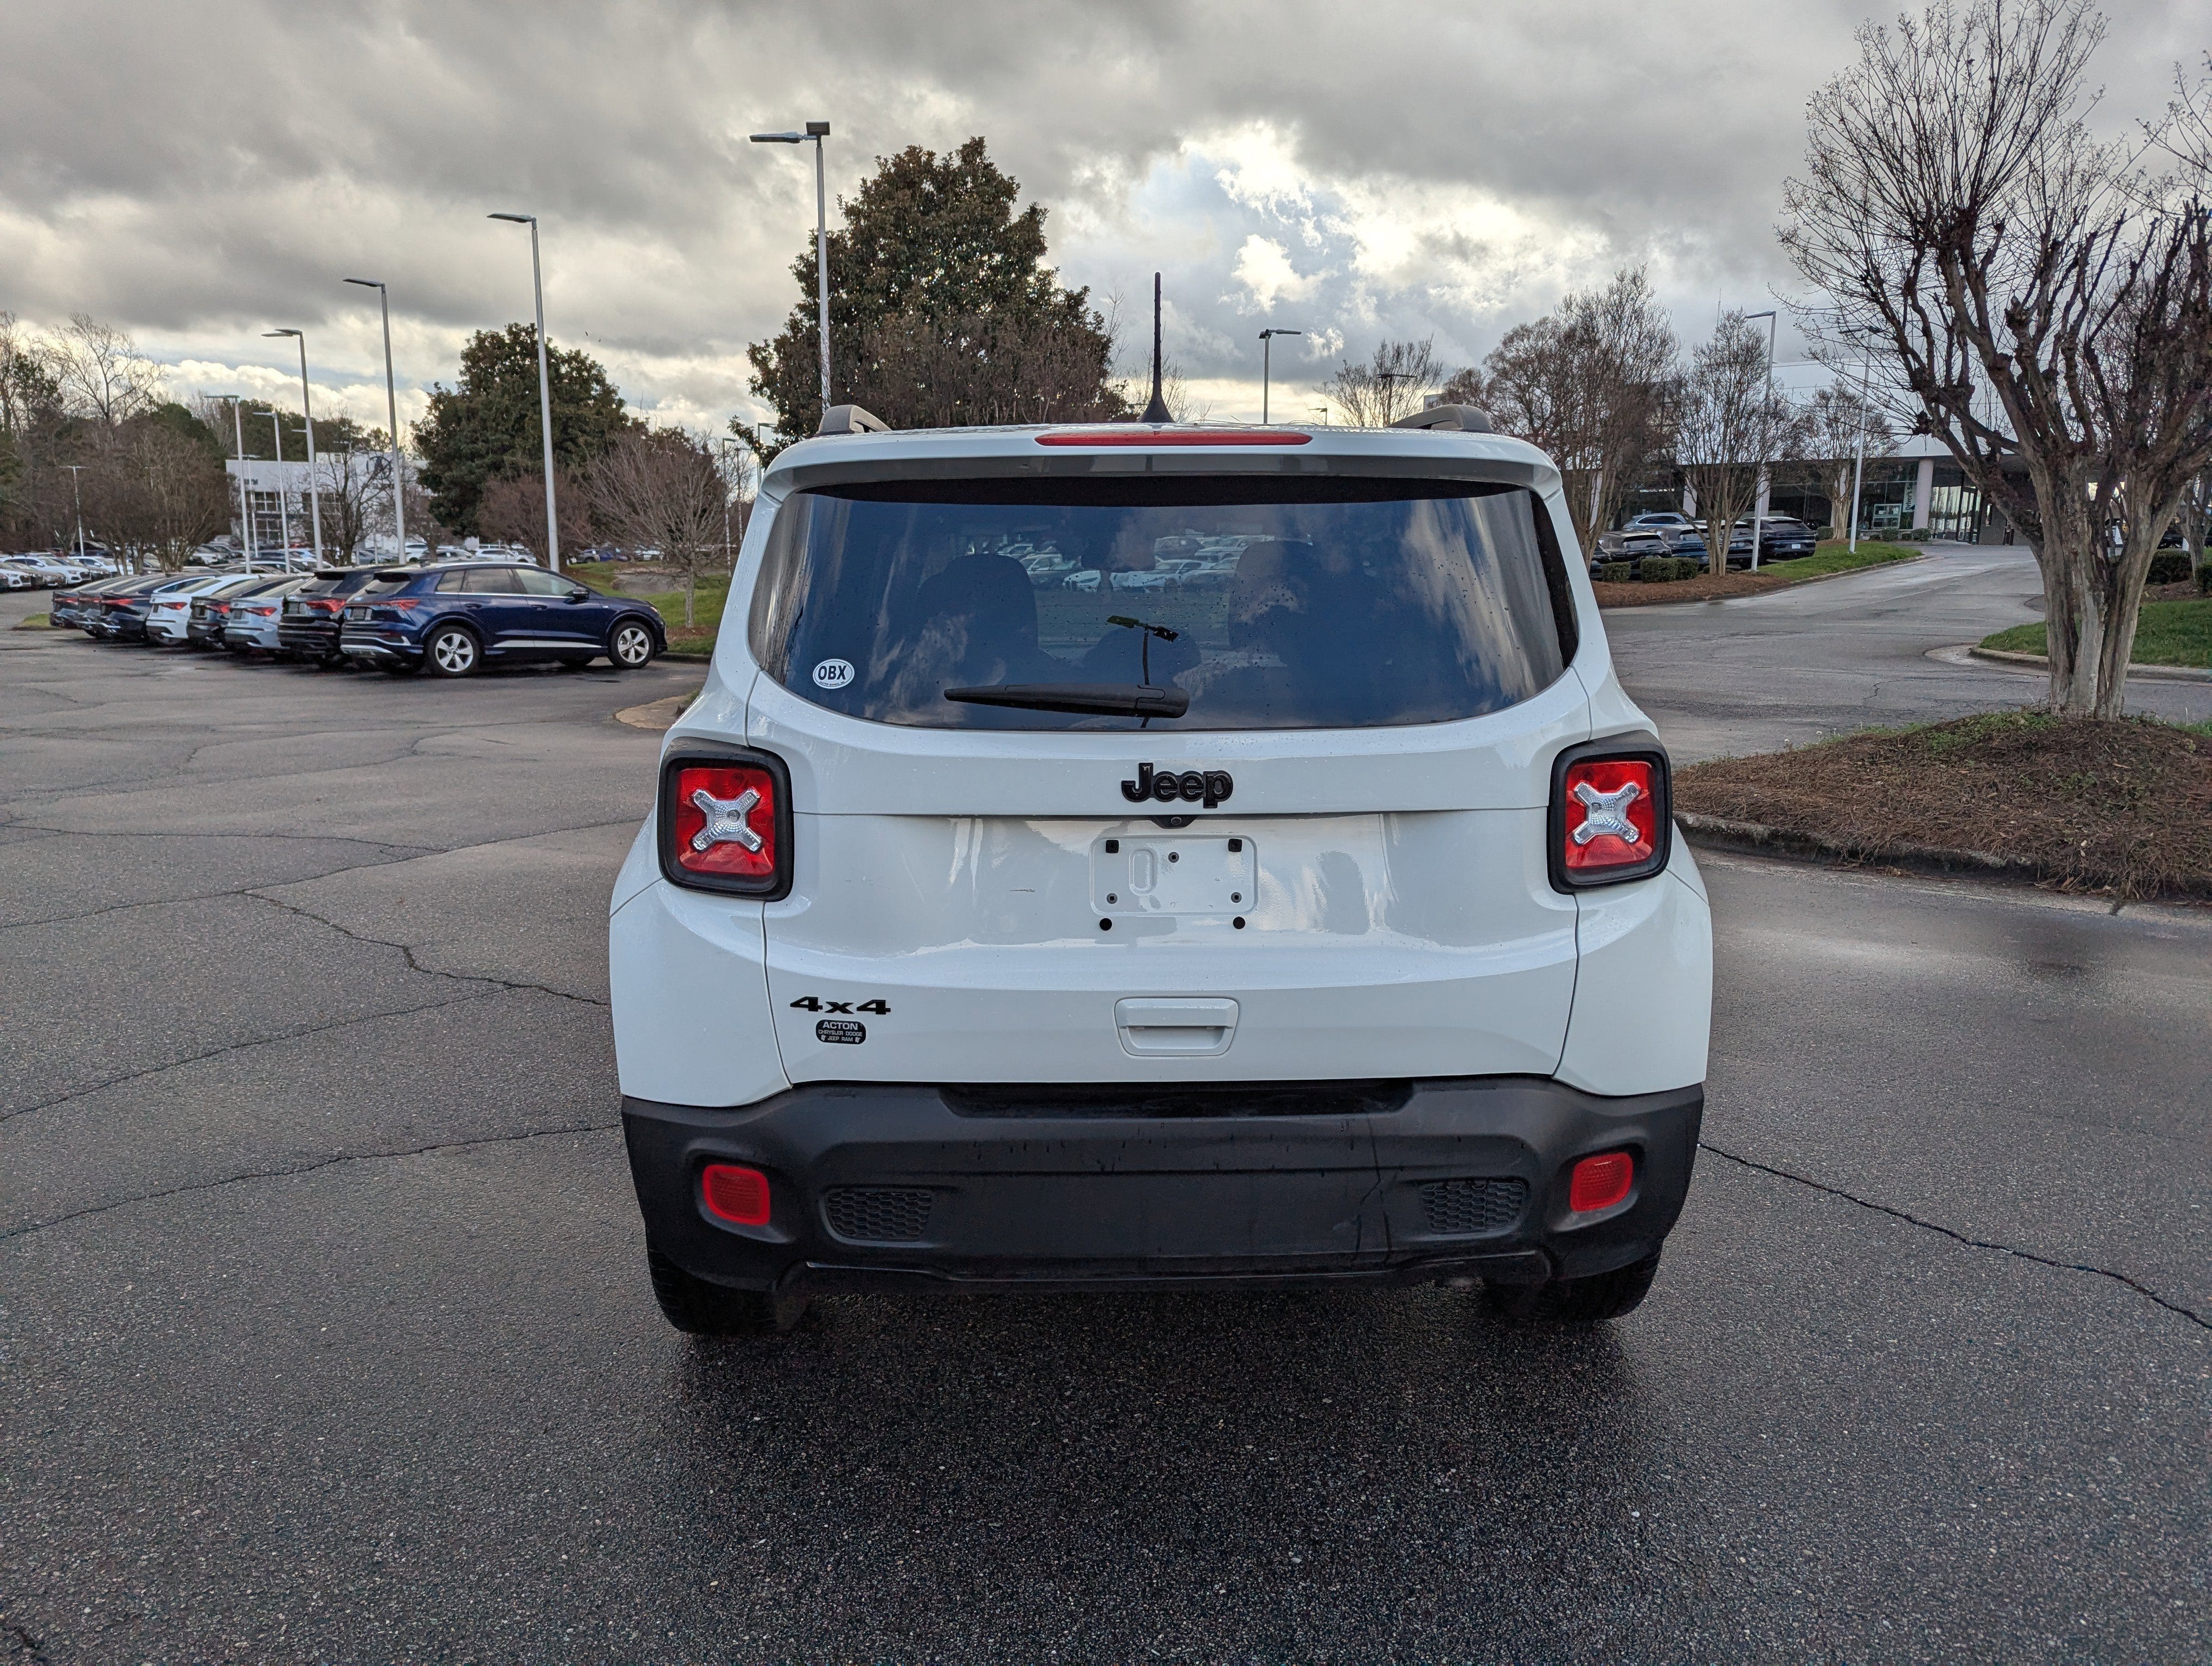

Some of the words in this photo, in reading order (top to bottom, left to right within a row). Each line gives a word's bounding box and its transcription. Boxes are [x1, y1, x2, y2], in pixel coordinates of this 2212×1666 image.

[818, 665, 847, 680] OBX
[1121, 762, 1233, 809] Jeep
[790, 996, 891, 1015] 4x4
[822, 1021, 858, 1030] ACTON
